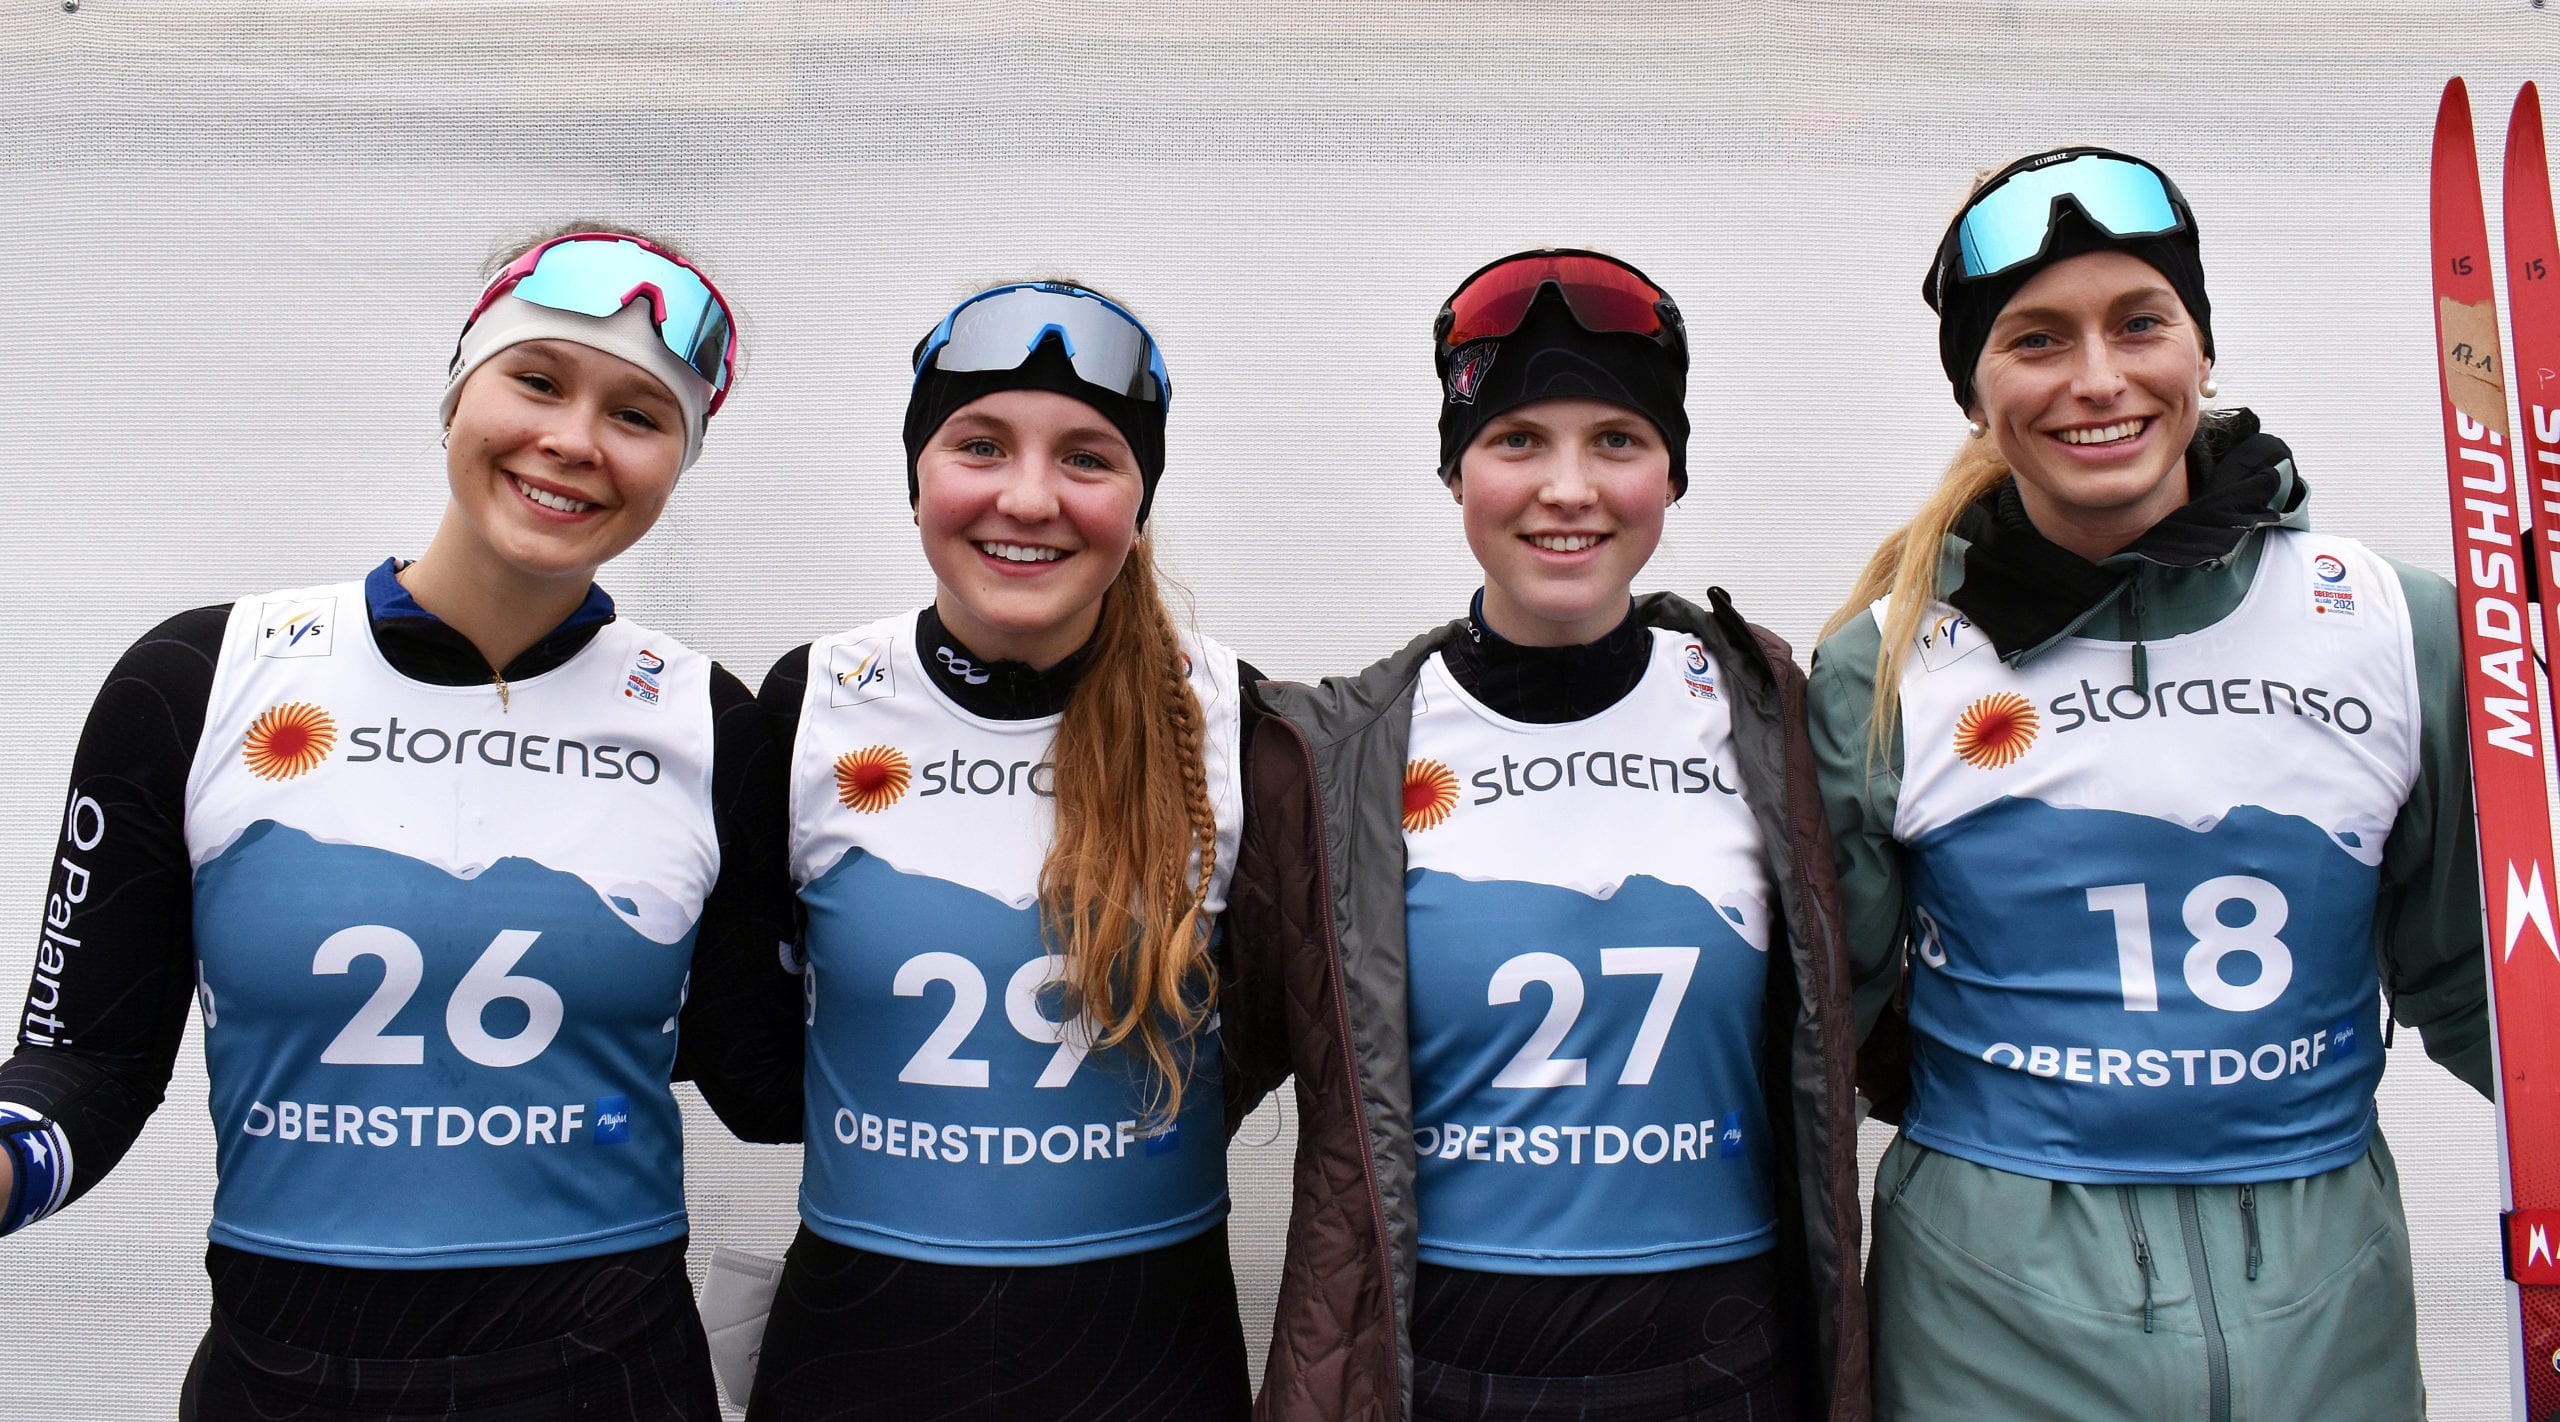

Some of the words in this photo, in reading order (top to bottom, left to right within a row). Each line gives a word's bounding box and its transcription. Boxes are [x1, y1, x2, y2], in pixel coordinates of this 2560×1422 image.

[2452, 256, 2473, 275] 15
[2525, 258, 2546, 281] 15
[2333, 598, 2355, 611] 2021
[266, 625, 324, 638] FIS
[1922, 620, 1971, 649] FIS
[639, 688, 659, 703] 2021
[837, 667, 885, 686] FIS
[26, 857, 91, 1048] Palanti
[2086, 874, 2293, 1013] 18
[312, 924, 565, 1068] 26
[892, 951, 1113, 1088] 29
[1488, 946, 1701, 1089] 27
[1982, 1029, 2327, 1087] OBERSTDORF
[243, 1100, 585, 1149] OBERSTDORF
[834, 1107, 1137, 1165] OBERSTDORF
[1413, 1119, 1715, 1165] OBERSTDORF
